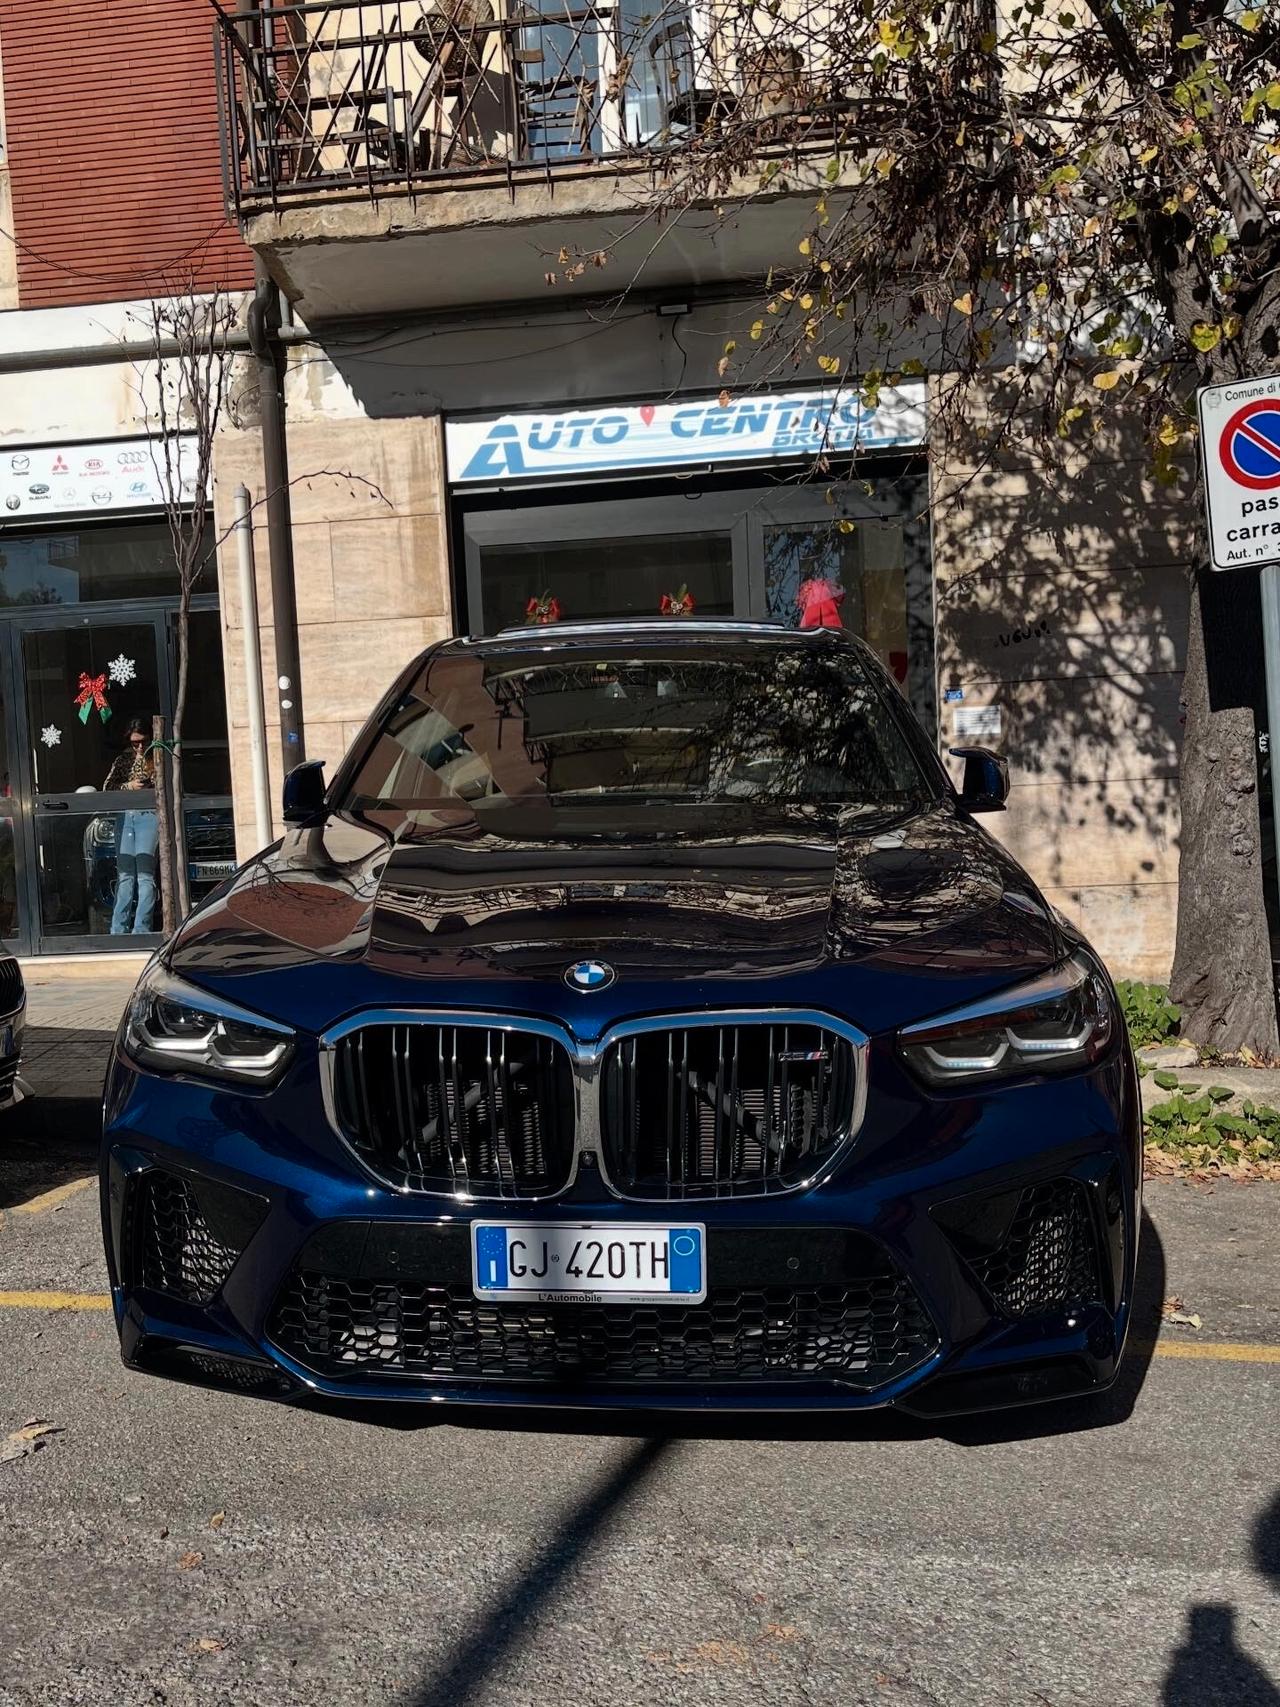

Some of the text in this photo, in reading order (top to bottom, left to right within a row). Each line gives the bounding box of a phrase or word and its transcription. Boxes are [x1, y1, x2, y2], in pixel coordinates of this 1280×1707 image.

[1225, 382, 1276, 401] Comune di
[459, 393, 878, 478] AUTO CENTRO
[1226, 521, 1280, 542] carra
[1227, 548, 1252, 561] Aut.
[509, 1240, 669, 1279] GJ 420TH
[538, 1293, 602, 1303] L'Automobile
